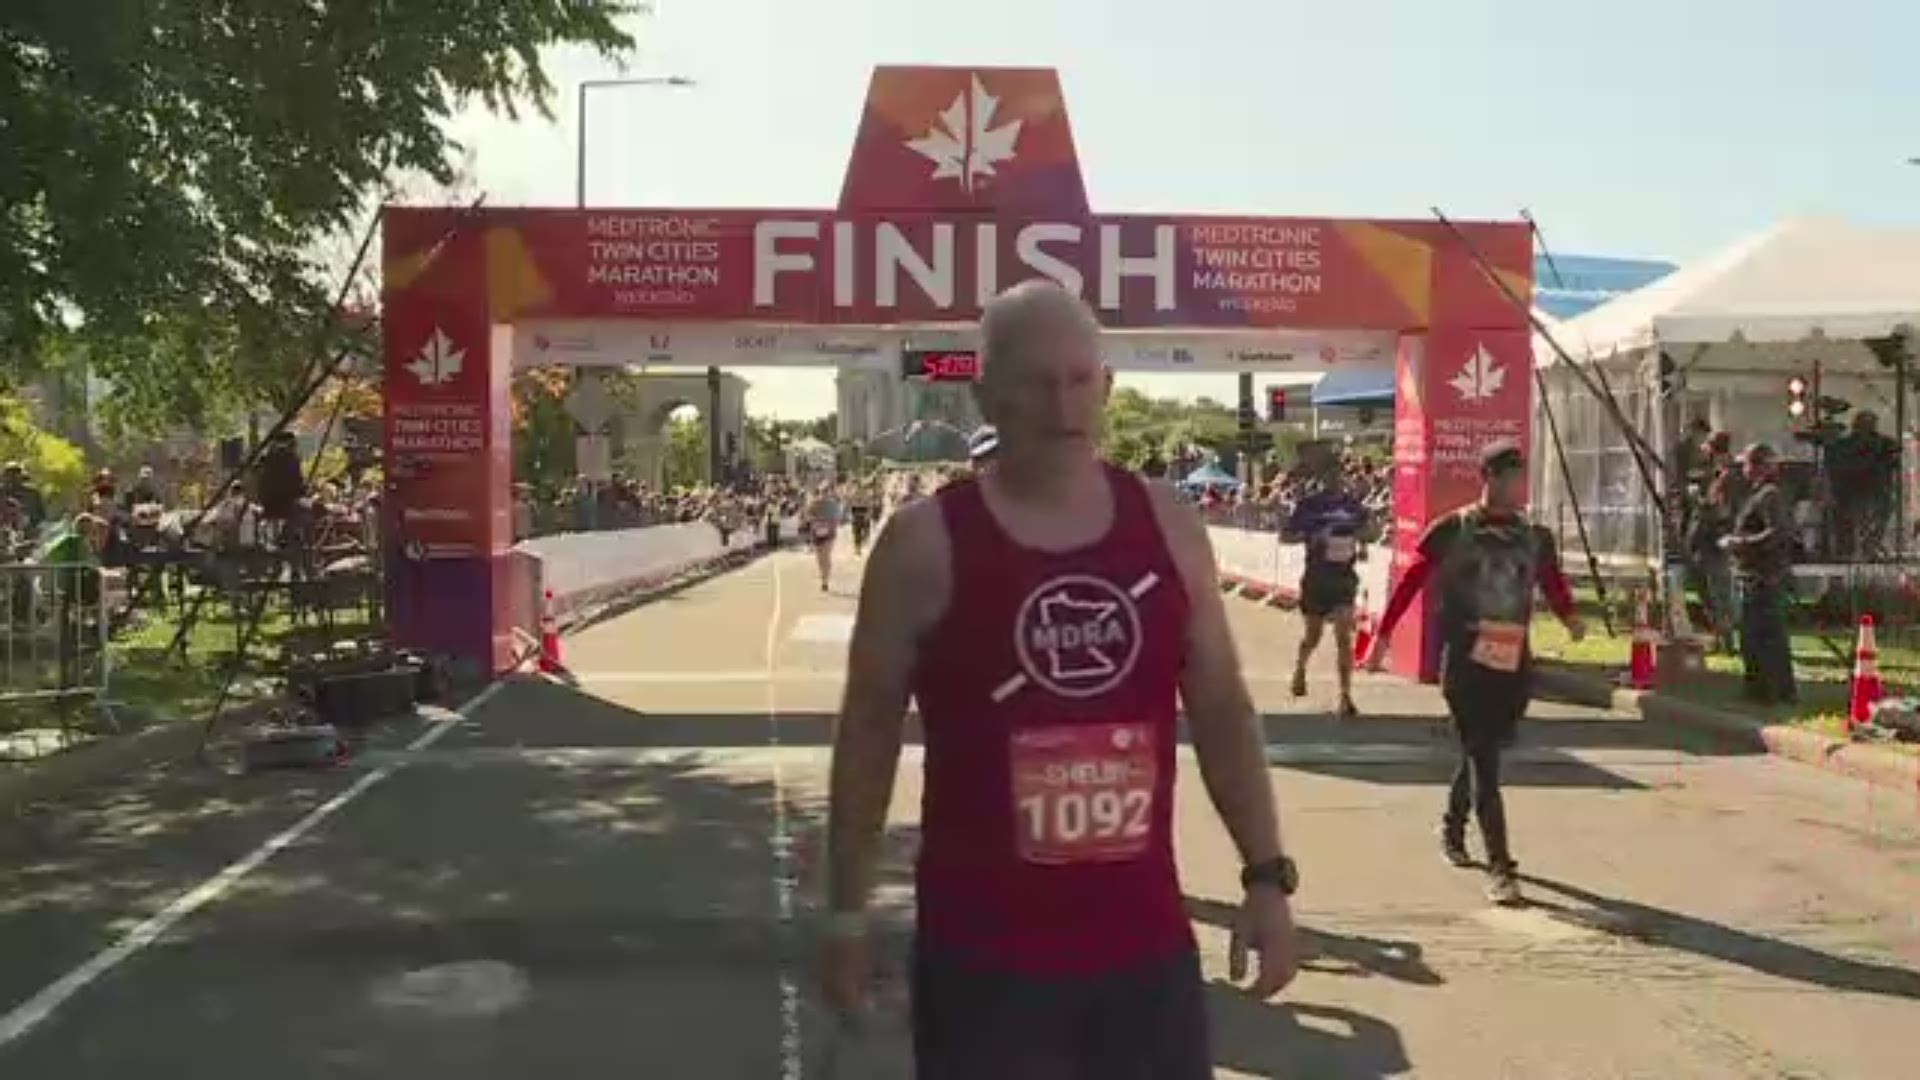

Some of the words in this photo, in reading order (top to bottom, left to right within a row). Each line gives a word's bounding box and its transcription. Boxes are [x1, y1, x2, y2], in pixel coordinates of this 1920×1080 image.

[587, 217, 720, 238] MEDTRONIC
[1192, 226, 1321, 245] MEDTRONIC
[588, 242, 642, 260] TWIN
[648, 242, 719, 261] CITIES
[1193, 249, 1248, 266] TWIN
[1251, 249, 1321, 268] CITIES
[587, 265, 719, 285] MARATHON
[754, 221, 1177, 309] FINISH
[1192, 271, 1321, 293] MARATHON
[1032, 619, 1126, 650] MDRA
[1019, 790, 1152, 842] 1092
